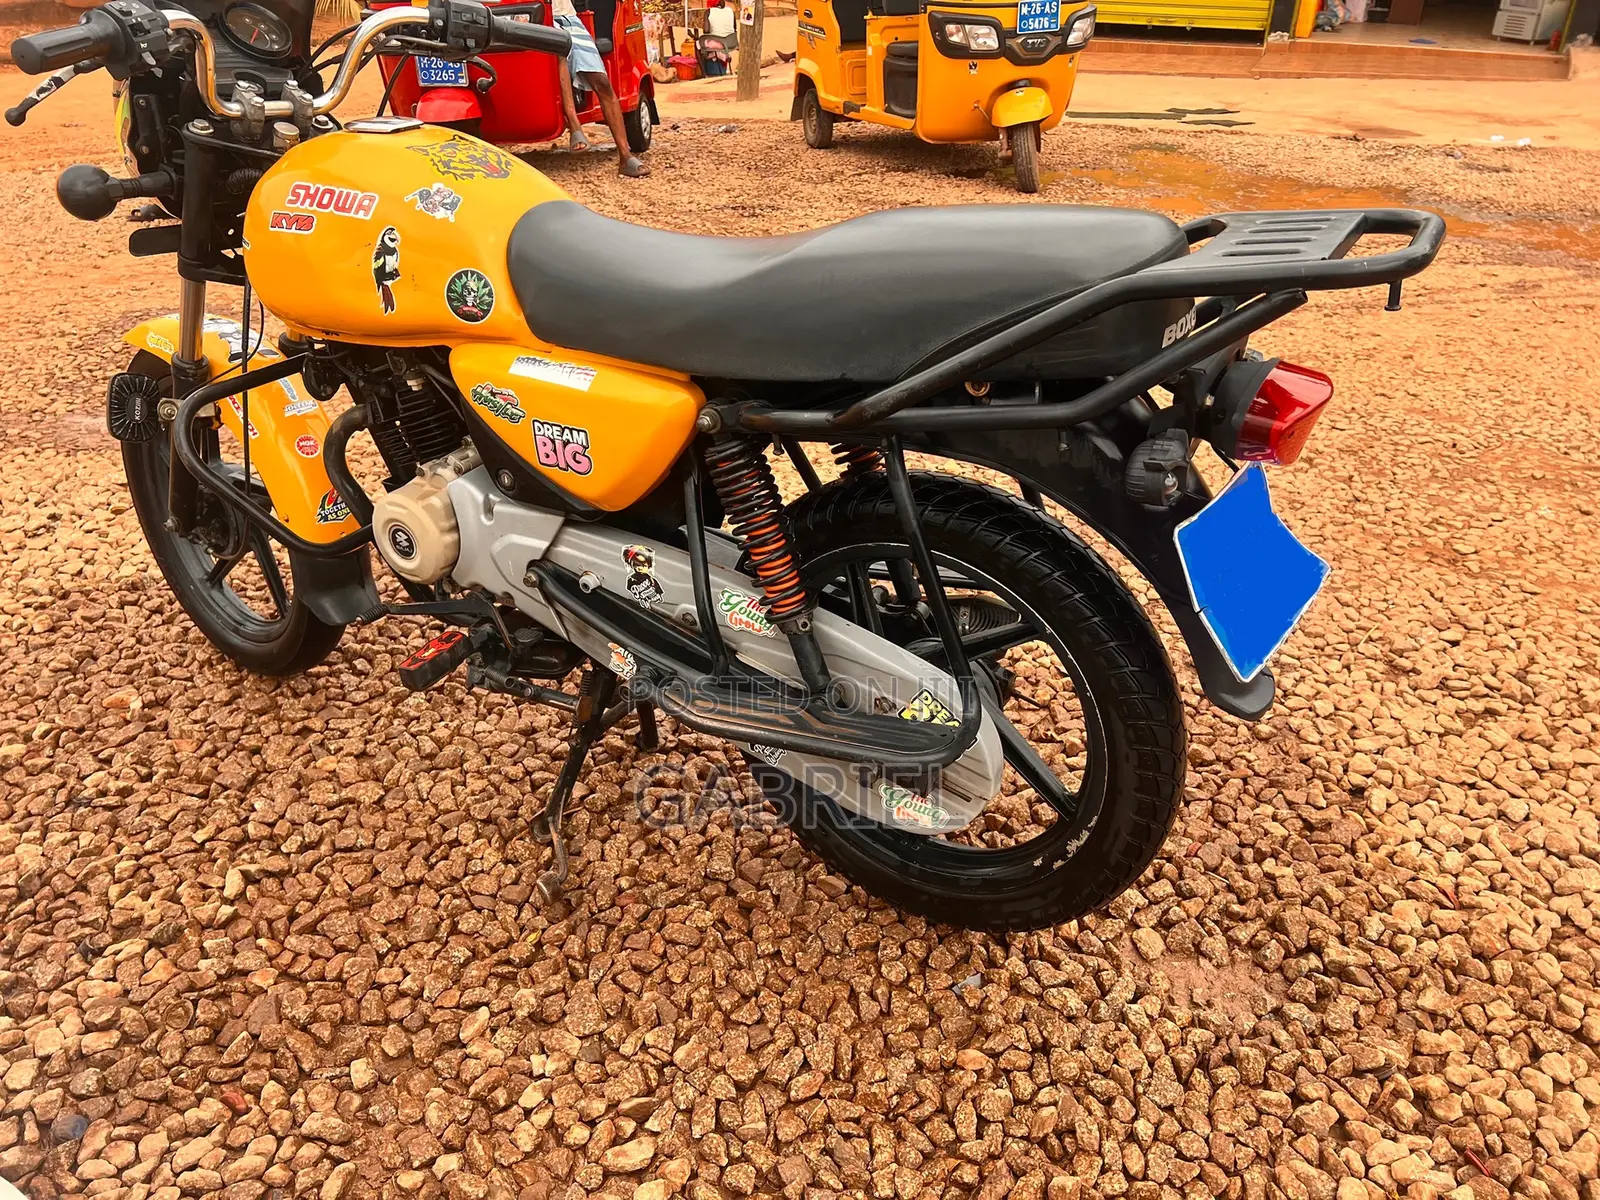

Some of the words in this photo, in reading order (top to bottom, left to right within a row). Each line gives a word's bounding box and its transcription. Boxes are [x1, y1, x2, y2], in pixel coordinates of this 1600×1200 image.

[1020, 1, 1058, 16] M-26-AS
[1028, 17, 1050, 30] 5476
[429, 69, 456, 81] 3265
[286, 183, 377, 218] SHOWA
[270, 212, 316, 232] KYB
[533, 420, 589, 448] DREAM
[535, 435, 591, 474] BIG
[320, 502, 347, 517] TOGETH
[719, 589, 774, 631] Young
[746, 595, 767, 614] The
